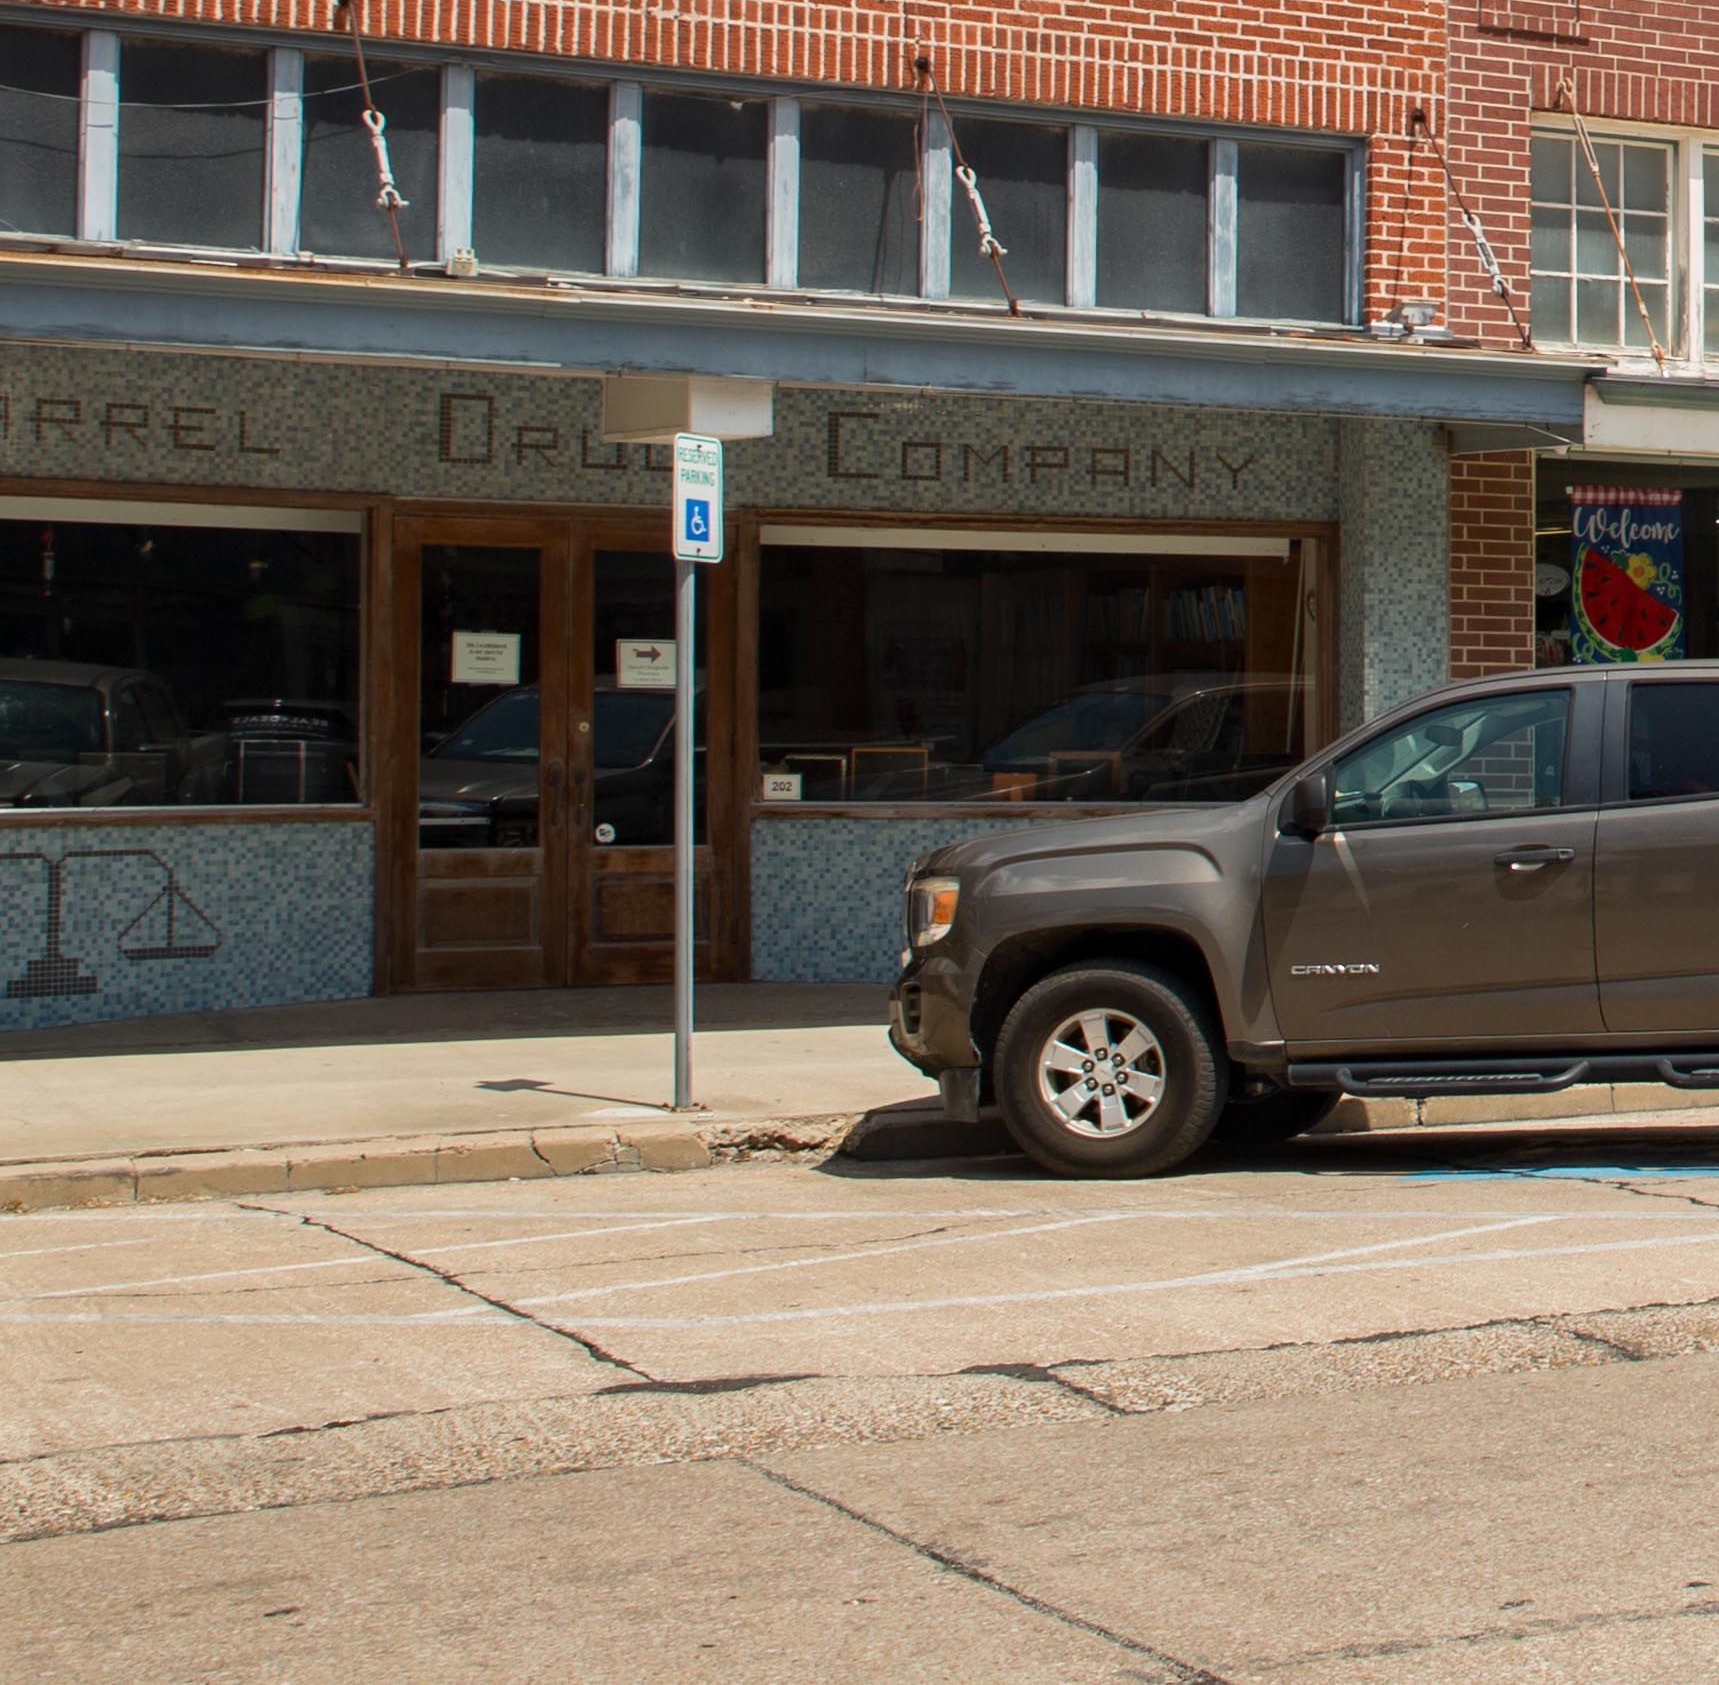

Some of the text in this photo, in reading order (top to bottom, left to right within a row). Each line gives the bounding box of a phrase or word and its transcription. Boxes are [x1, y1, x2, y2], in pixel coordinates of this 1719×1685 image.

[0, 394, 282, 454] RREL
[828, 411, 1256, 490] COMPANY
[678, 447, 717, 466] RESERVED
[680, 468, 716, 486] PARKING
[1573, 507, 1680, 548] Welcome
[771, 781, 793, 792] 202
[1291, 964, 1379, 975] CANYON
